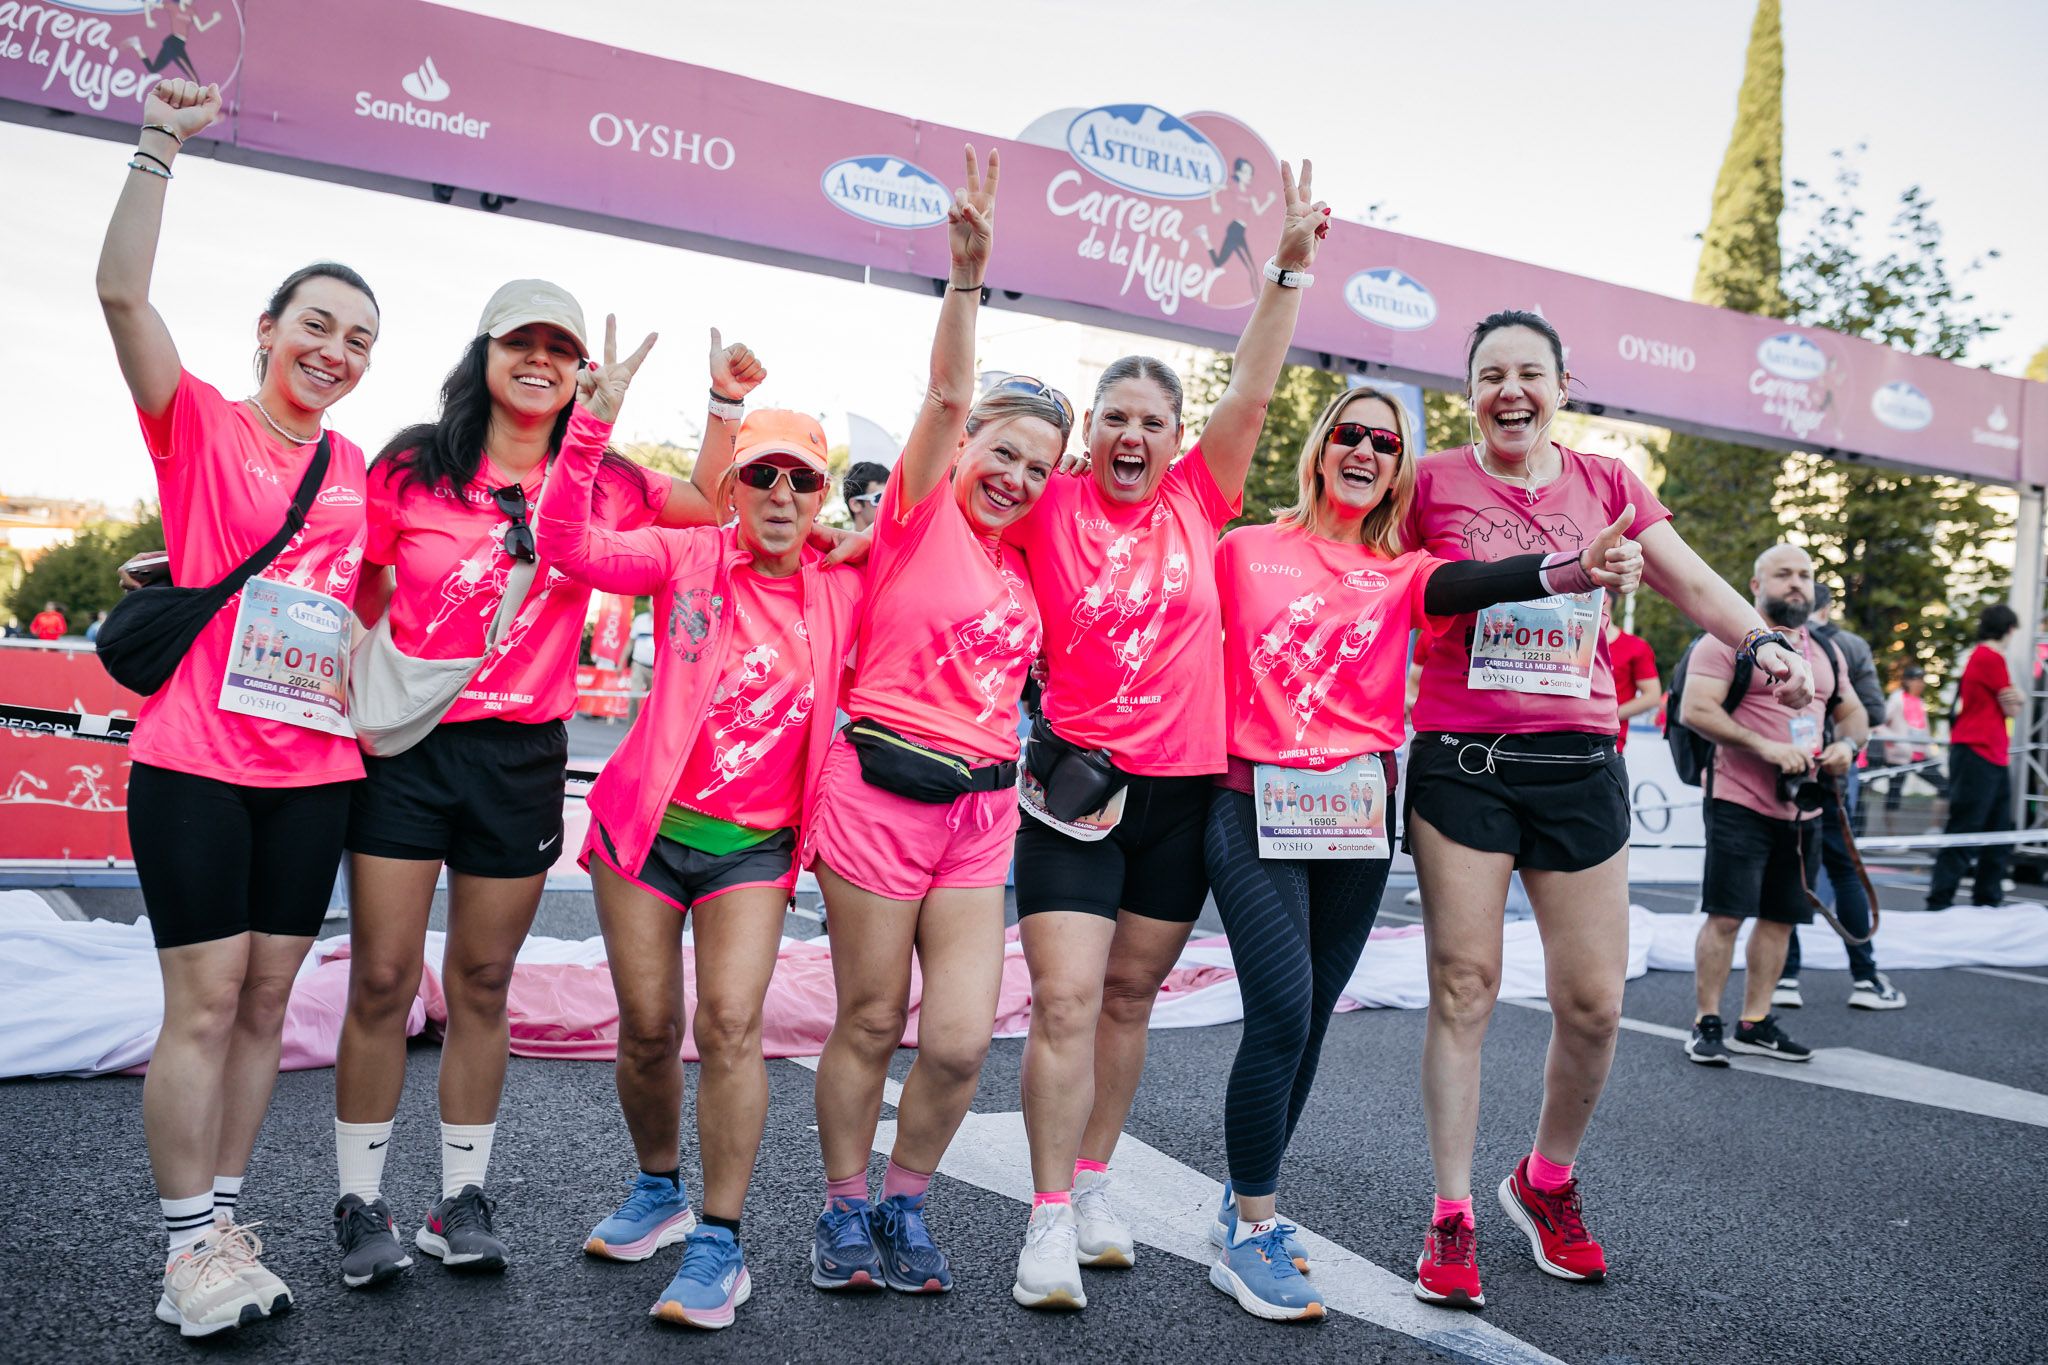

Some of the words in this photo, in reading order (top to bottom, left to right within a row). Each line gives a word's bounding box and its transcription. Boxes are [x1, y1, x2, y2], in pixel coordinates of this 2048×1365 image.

[0, 1, 112, 49] arrera
[28, 36, 49, 67] la
[41, 39, 162, 111] Mujer
[355, 91, 491, 139] Santander
[589, 112, 736, 171] OYSHO
[1080, 123, 1212, 184] ASTURIANA
[833, 172, 942, 215] ASTURIANA
[1046, 169, 1184, 241] Carrera
[1077, 226, 1106, 260] de
[1108, 230, 1129, 266] la
[1119, 233, 1226, 315] Mujer
[1618, 334, 1696, 372] OYSHO
[434, 486, 494, 505] OYHO
[1250, 562, 1302, 578] OYSHO
[1515, 628, 1564, 647] 016
[284, 647, 335, 678] 016
[1485, 660, 1513, 668] CARRERA
[1535, 663, 1557, 671] MUJER
[1522, 651, 1551, 661] 12218
[244, 678, 277, 692] CARRERA
[279, 686, 289, 695] DE
[290, 688, 299, 697] LA
[301, 690, 325, 703] MUJER
[288, 675, 320, 690] 20244
[239, 694, 286, 713] OYSHO
[1116, 705, 1133, 713] 2024
[1119, 696, 1129, 704] DE
[1130, 696, 1138, 704] LA
[1139, 696, 1162, 704] MUJER
[1278, 748, 1309, 760] CARRERA
[1309, 747, 1319, 756] DE
[1319, 747, 1329, 755] LA
[1308, 756, 1326, 766] 2024
[1299, 794, 1347, 813] 016
[1073, 821, 1099, 831] MADRID
[1309, 817, 1337, 826] 16905
[1273, 828, 1302, 836] CARRERA
[1322, 828, 1344, 836] MUJER
[1348, 828, 1373, 836] MADRID
[1272, 841, 1313, 852] OYSHO
[1338, 843, 1376, 851] Santander
